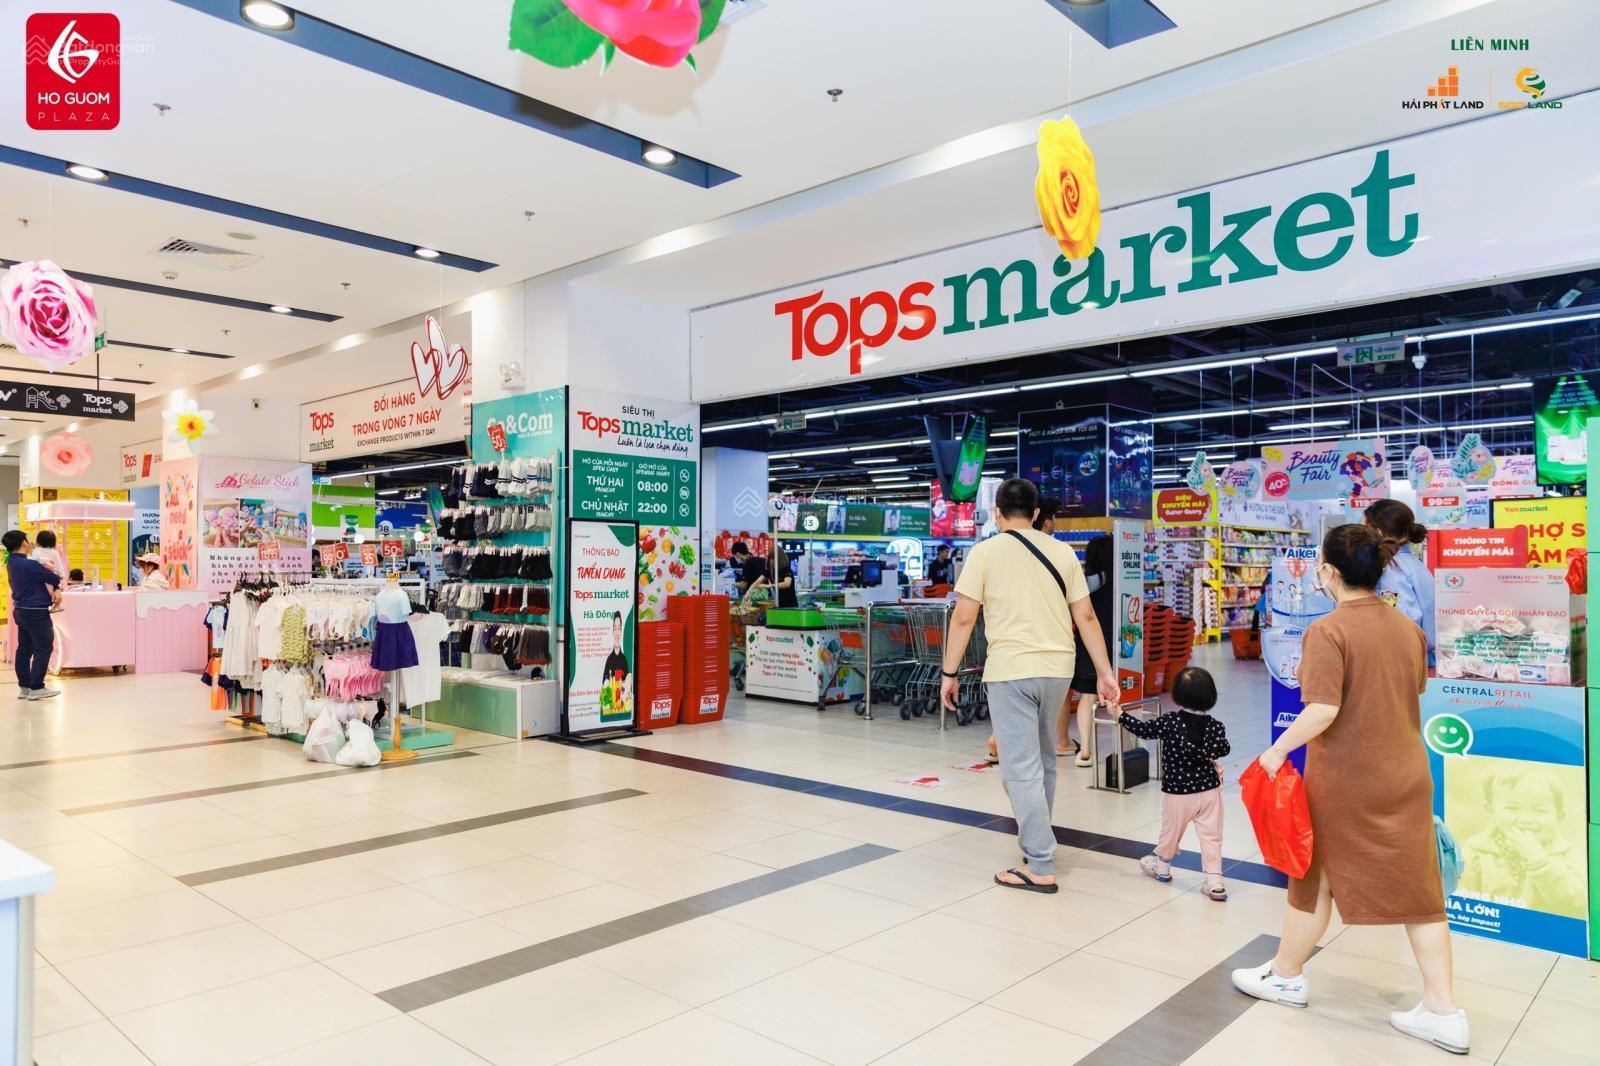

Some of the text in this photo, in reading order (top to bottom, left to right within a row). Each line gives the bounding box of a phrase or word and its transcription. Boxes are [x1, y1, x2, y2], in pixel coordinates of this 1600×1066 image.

[83, 393, 112, 406] Tops
[374, 392, 416, 412] ĐỔI HÀNG
[83, 406, 112, 414] market
[622, 405, 655, 420] SIÊU THỊ
[309, 412, 335, 435] Tops
[352, 407, 442, 436] TRONG VÒNG 7 NGÀY
[357, 438, 380, 447] EXCHANGE
[380, 433, 404, 442] PRODUCTS
[404, 430, 420, 439] WITHIN
[426, 428, 436, 436] DAY
[310, 438, 335, 452] market
[1287, 449, 1343, 473] Beauty
[1226, 468, 1255, 480] Beauty
[1301, 466, 1332, 484] Fair
[586, 475, 624, 487] THỨ HAI
[637, 481, 668, 492] 08:00
[1232, 478, 1250, 488] Fair
[581, 498, 629, 514] CHỦ NHẬT
[637, 502, 668, 514] 22:00
[1528, 521, 1564, 542] HỢ
[1453, 536, 1486, 545] THÔNG
[582, 546, 606, 556] THÔNG
[1121, 550, 1132, 560] SIÊU
[1442, 544, 1490, 557] KHUYẾN
[1528, 544, 1562, 564] ẢM
[584, 610, 594, 618] Hà
[654, 701, 670, 711] Tops
[704, 696, 718, 706] Tops
[1466, 902, 1500, 918] LỚN!
[1471, 919, 1501, 928] impact!
